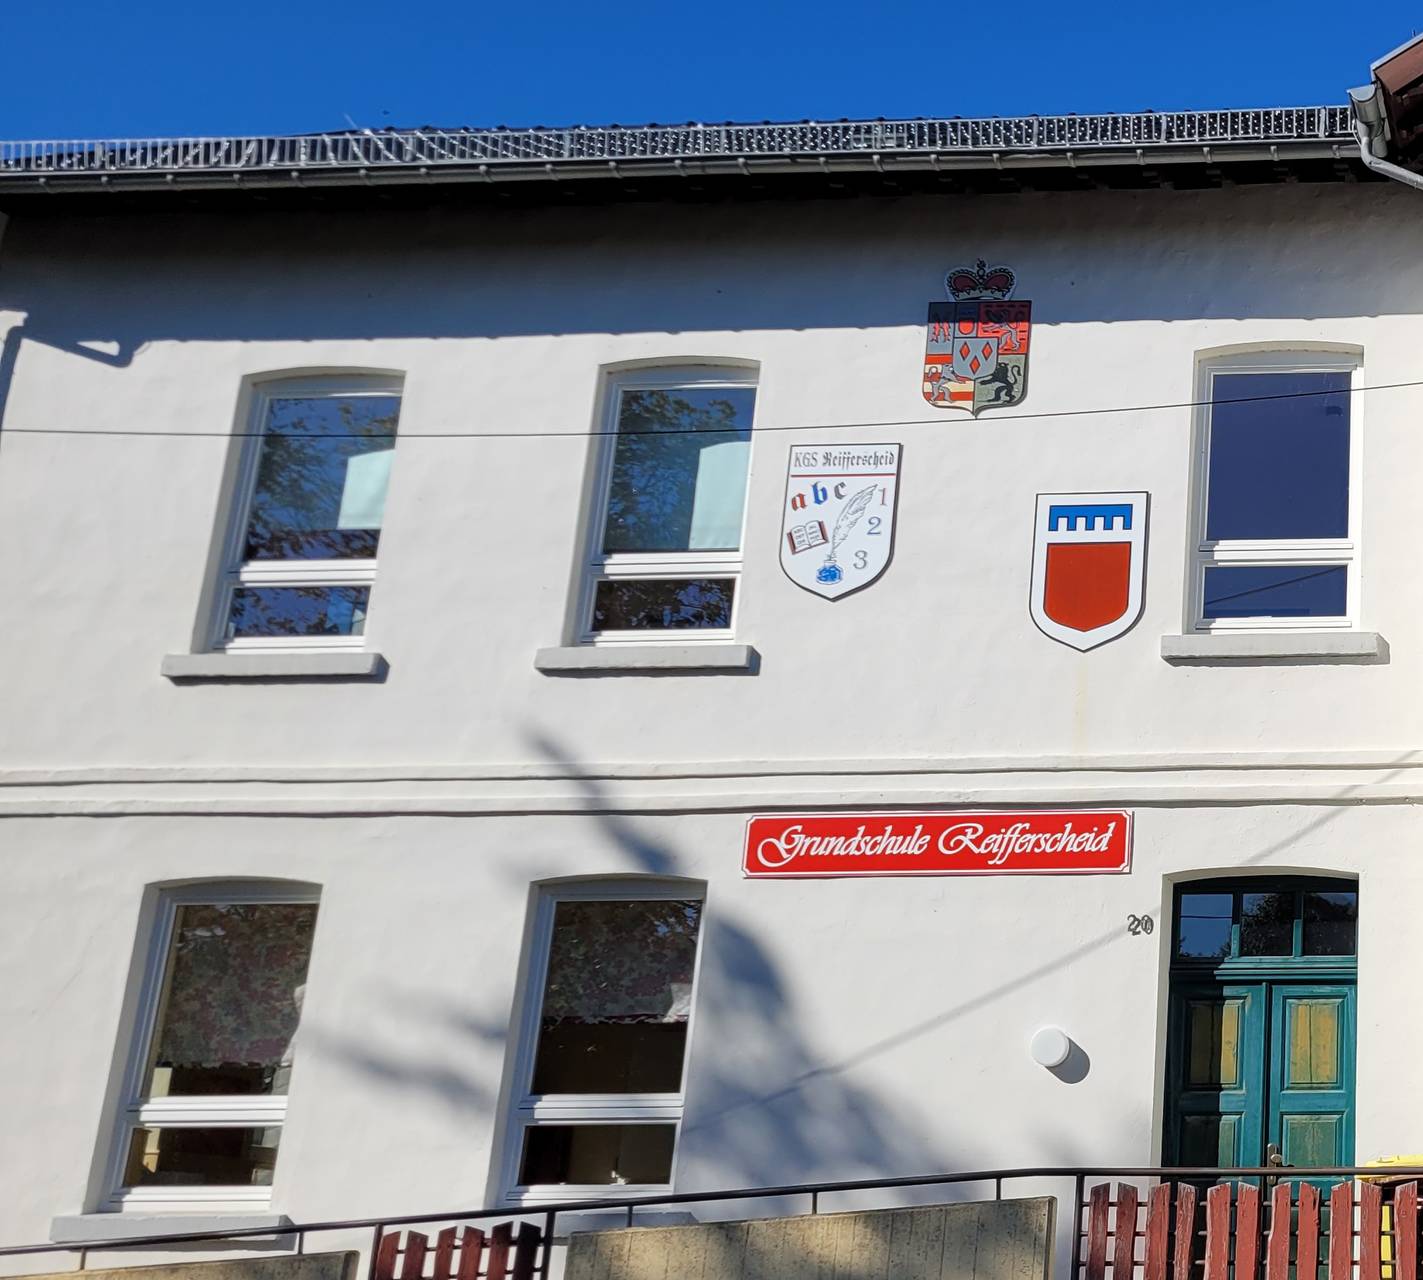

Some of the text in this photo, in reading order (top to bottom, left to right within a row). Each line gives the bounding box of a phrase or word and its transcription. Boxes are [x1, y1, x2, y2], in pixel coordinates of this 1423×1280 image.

[793, 450, 895, 470] KGS Reifferscheid
[878, 488, 888, 506] 1
[867, 516, 881, 535] 2
[853, 550, 868, 570] 3
[757, 822, 1116, 867] Grundschule Reifferscheid
[1127, 914, 1154, 936] 20
